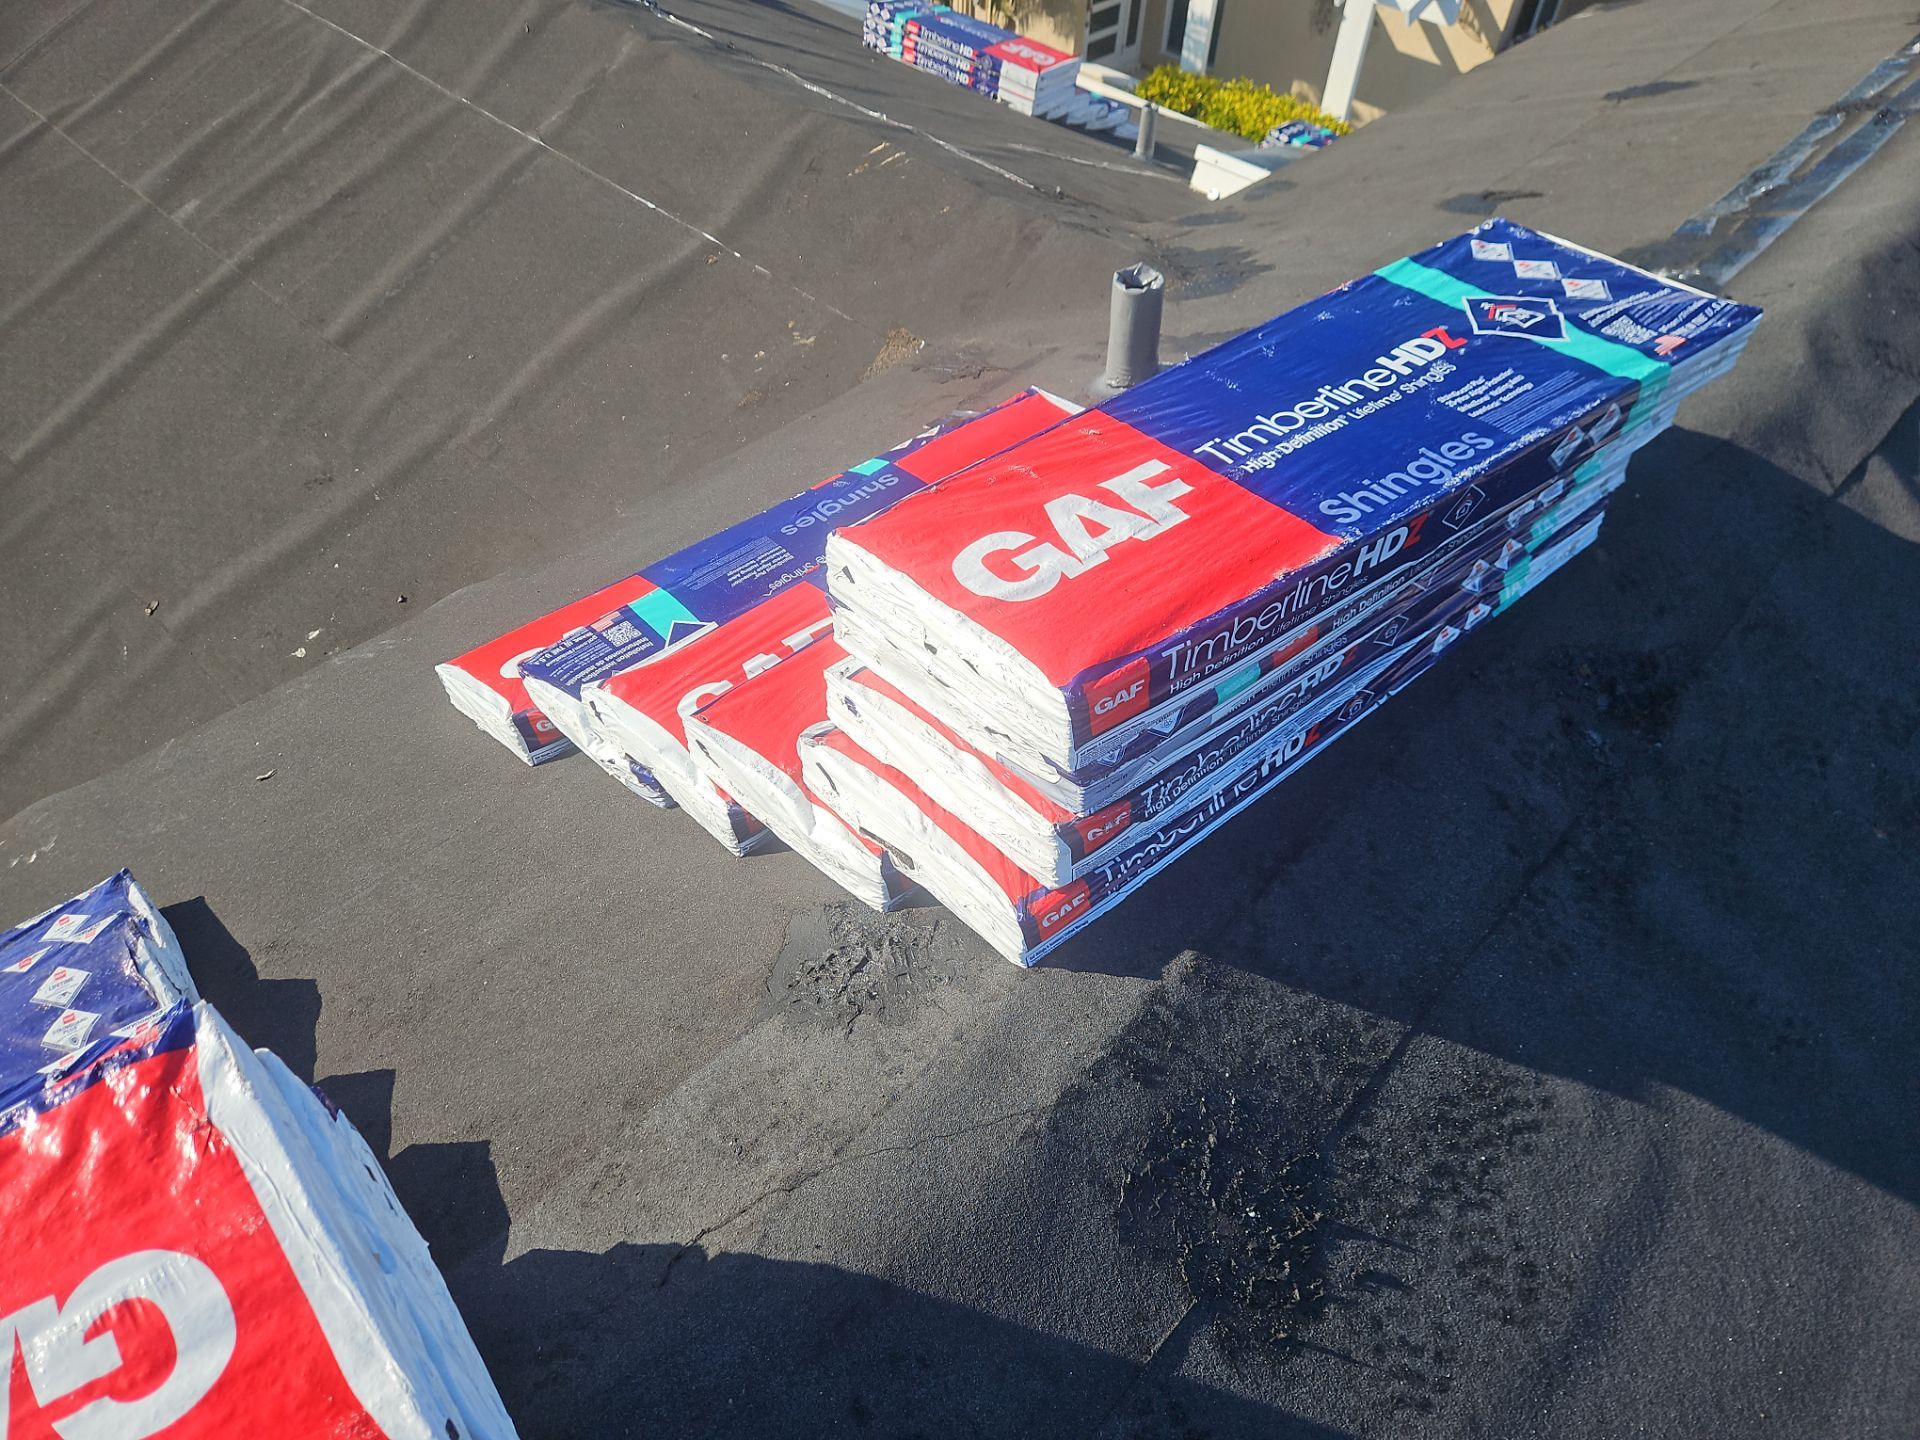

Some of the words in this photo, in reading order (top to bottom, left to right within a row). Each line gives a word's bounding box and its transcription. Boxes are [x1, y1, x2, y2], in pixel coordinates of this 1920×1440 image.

[1400, 359, 1457, 394] Shingles
[781, 473, 899, 536] Shingles
[1319, 431, 1495, 526] Shingles
[952, 459, 1195, 602] GAF
[1162, 512, 1428, 681] TimberlineHDZ
[1170, 673, 1200, 695] High
[1321, 575, 1368, 609] Shingles
[1094, 679, 1146, 716] GAF
